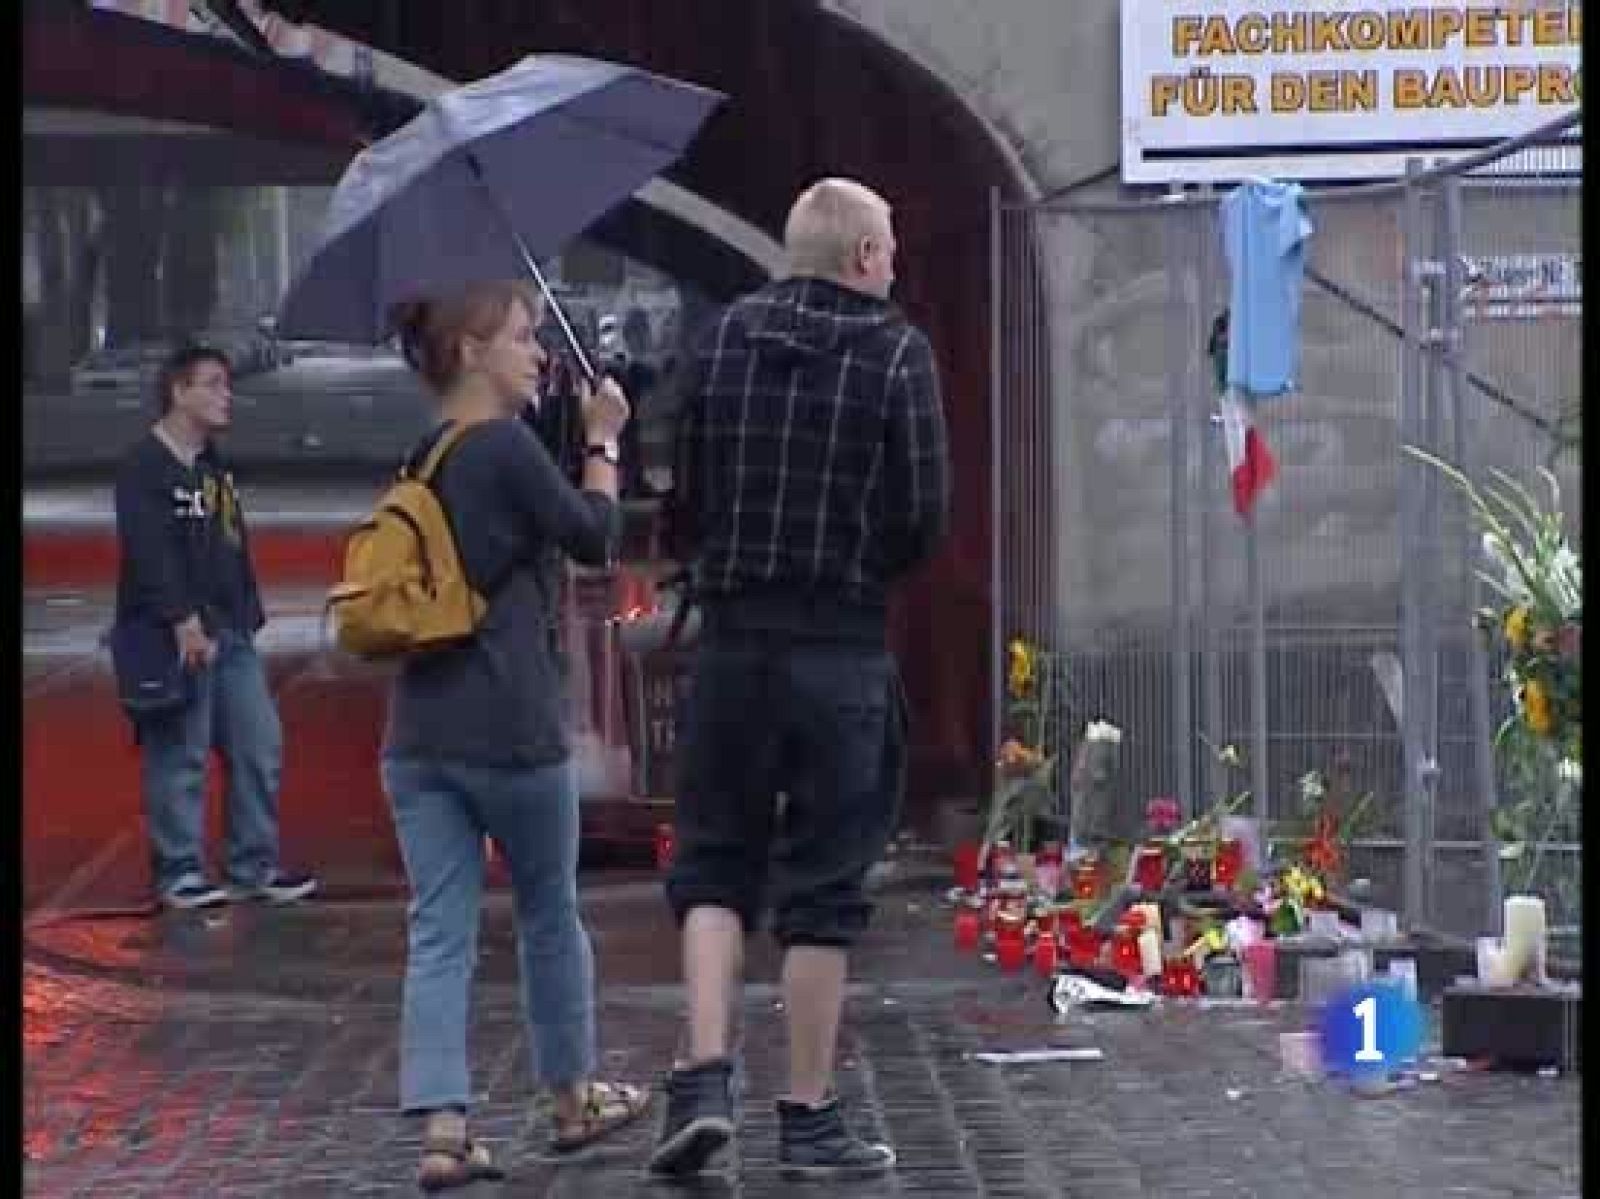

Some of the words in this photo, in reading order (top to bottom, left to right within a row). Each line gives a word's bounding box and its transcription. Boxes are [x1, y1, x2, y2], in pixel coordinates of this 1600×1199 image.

[1152, 66, 1259, 117] FÜR
[1271, 69, 1379, 114] DEN
[1393, 63, 1582, 109] BAUPR
